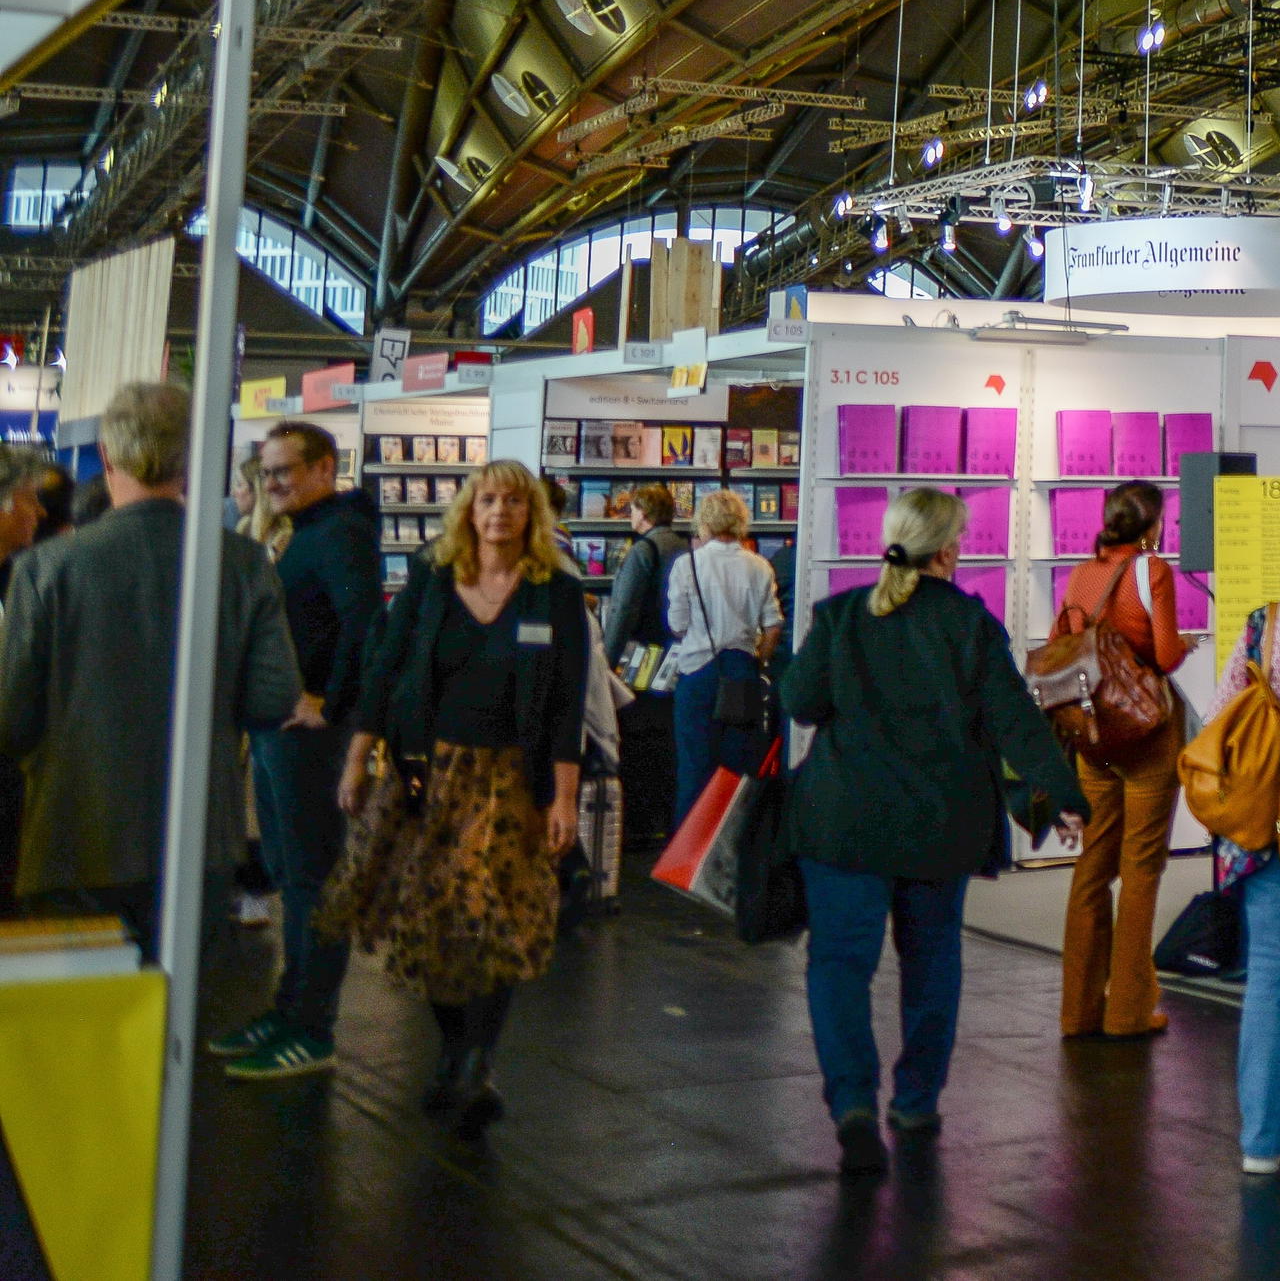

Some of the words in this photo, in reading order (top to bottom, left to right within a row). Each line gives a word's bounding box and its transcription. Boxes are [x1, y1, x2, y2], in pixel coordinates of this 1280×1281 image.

[1068, 245, 1141, 277] Frankfurter
[1141, 240, 1241, 268] Allgemeine
[830, 370, 851, 385] 3.1
[855, 370, 868, 385] C
[874, 371, 900, 386] 105
